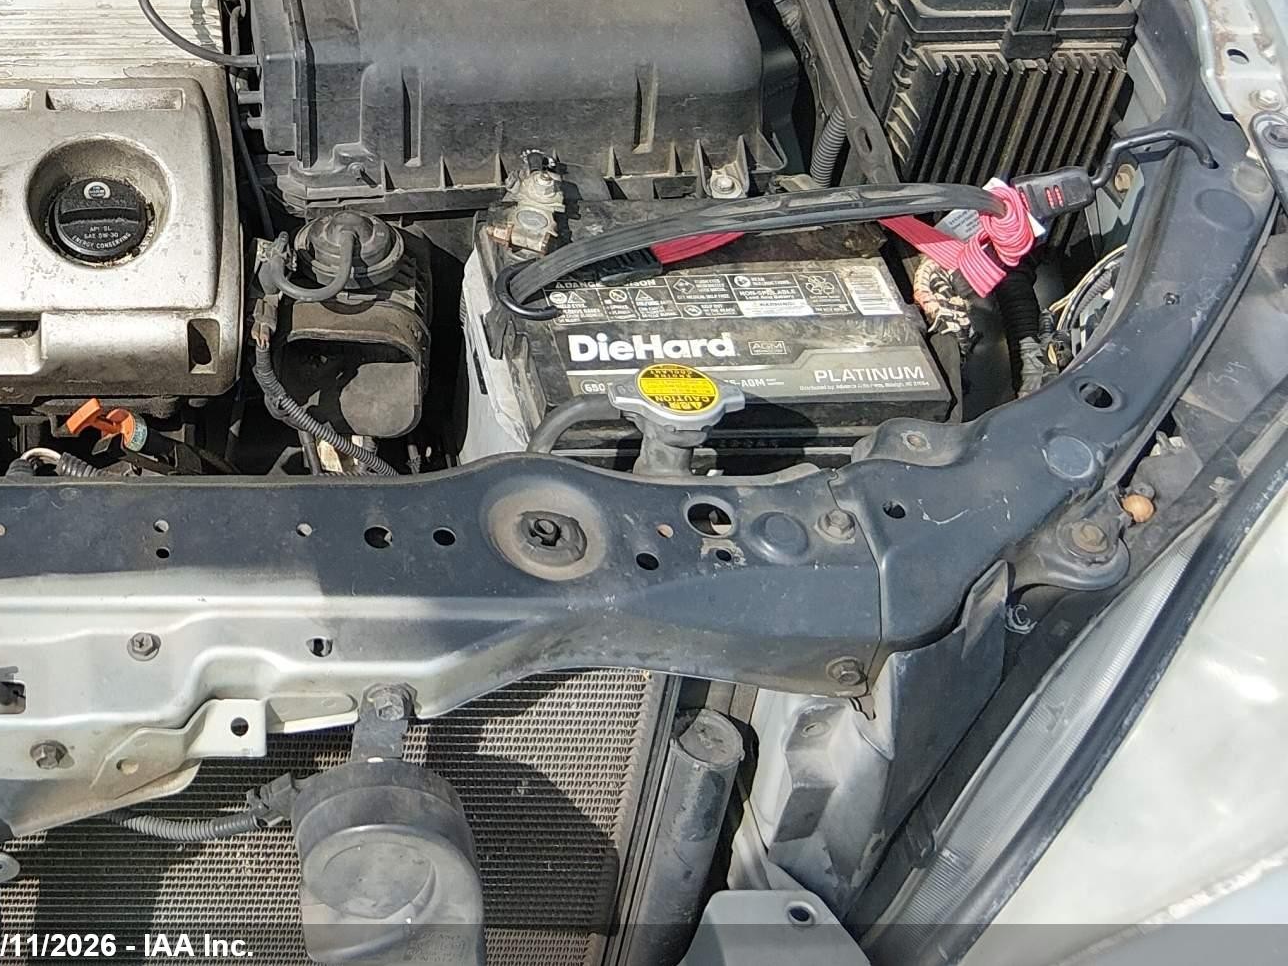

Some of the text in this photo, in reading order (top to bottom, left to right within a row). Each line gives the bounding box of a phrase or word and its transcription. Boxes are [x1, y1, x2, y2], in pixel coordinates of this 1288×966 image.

[72, 232, 132, 249] ENERGY CONSERVING
[568, 332, 737, 362] DieHard
[814, 366, 925, 384] PLATINUM
[655, 394, 710, 403] CAUTION
